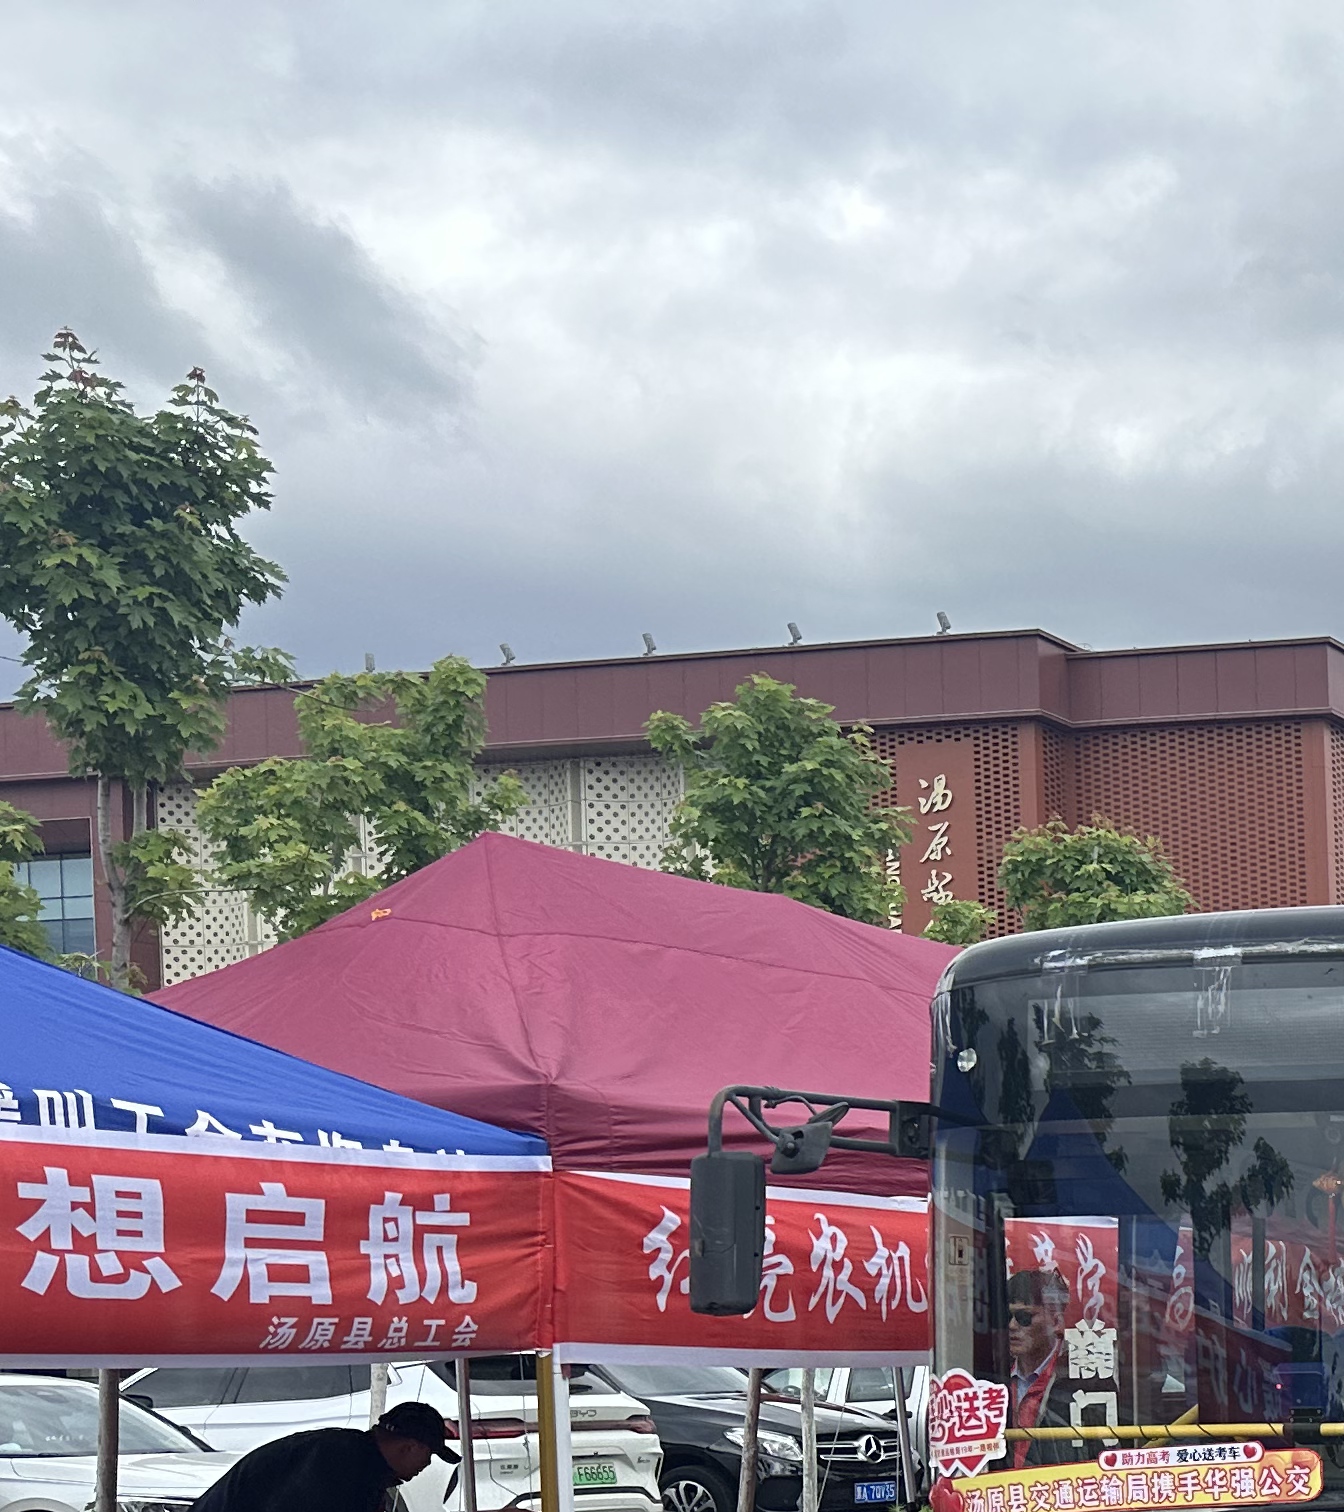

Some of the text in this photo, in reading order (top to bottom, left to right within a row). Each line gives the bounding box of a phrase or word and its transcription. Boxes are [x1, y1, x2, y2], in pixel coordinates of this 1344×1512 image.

[16, 1166, 479, 1305] 想启航
[258, 1314, 480, 1349] 汤原县总工会
[1120, 1444, 1242, 1467] 助力高考 爱心送考车
